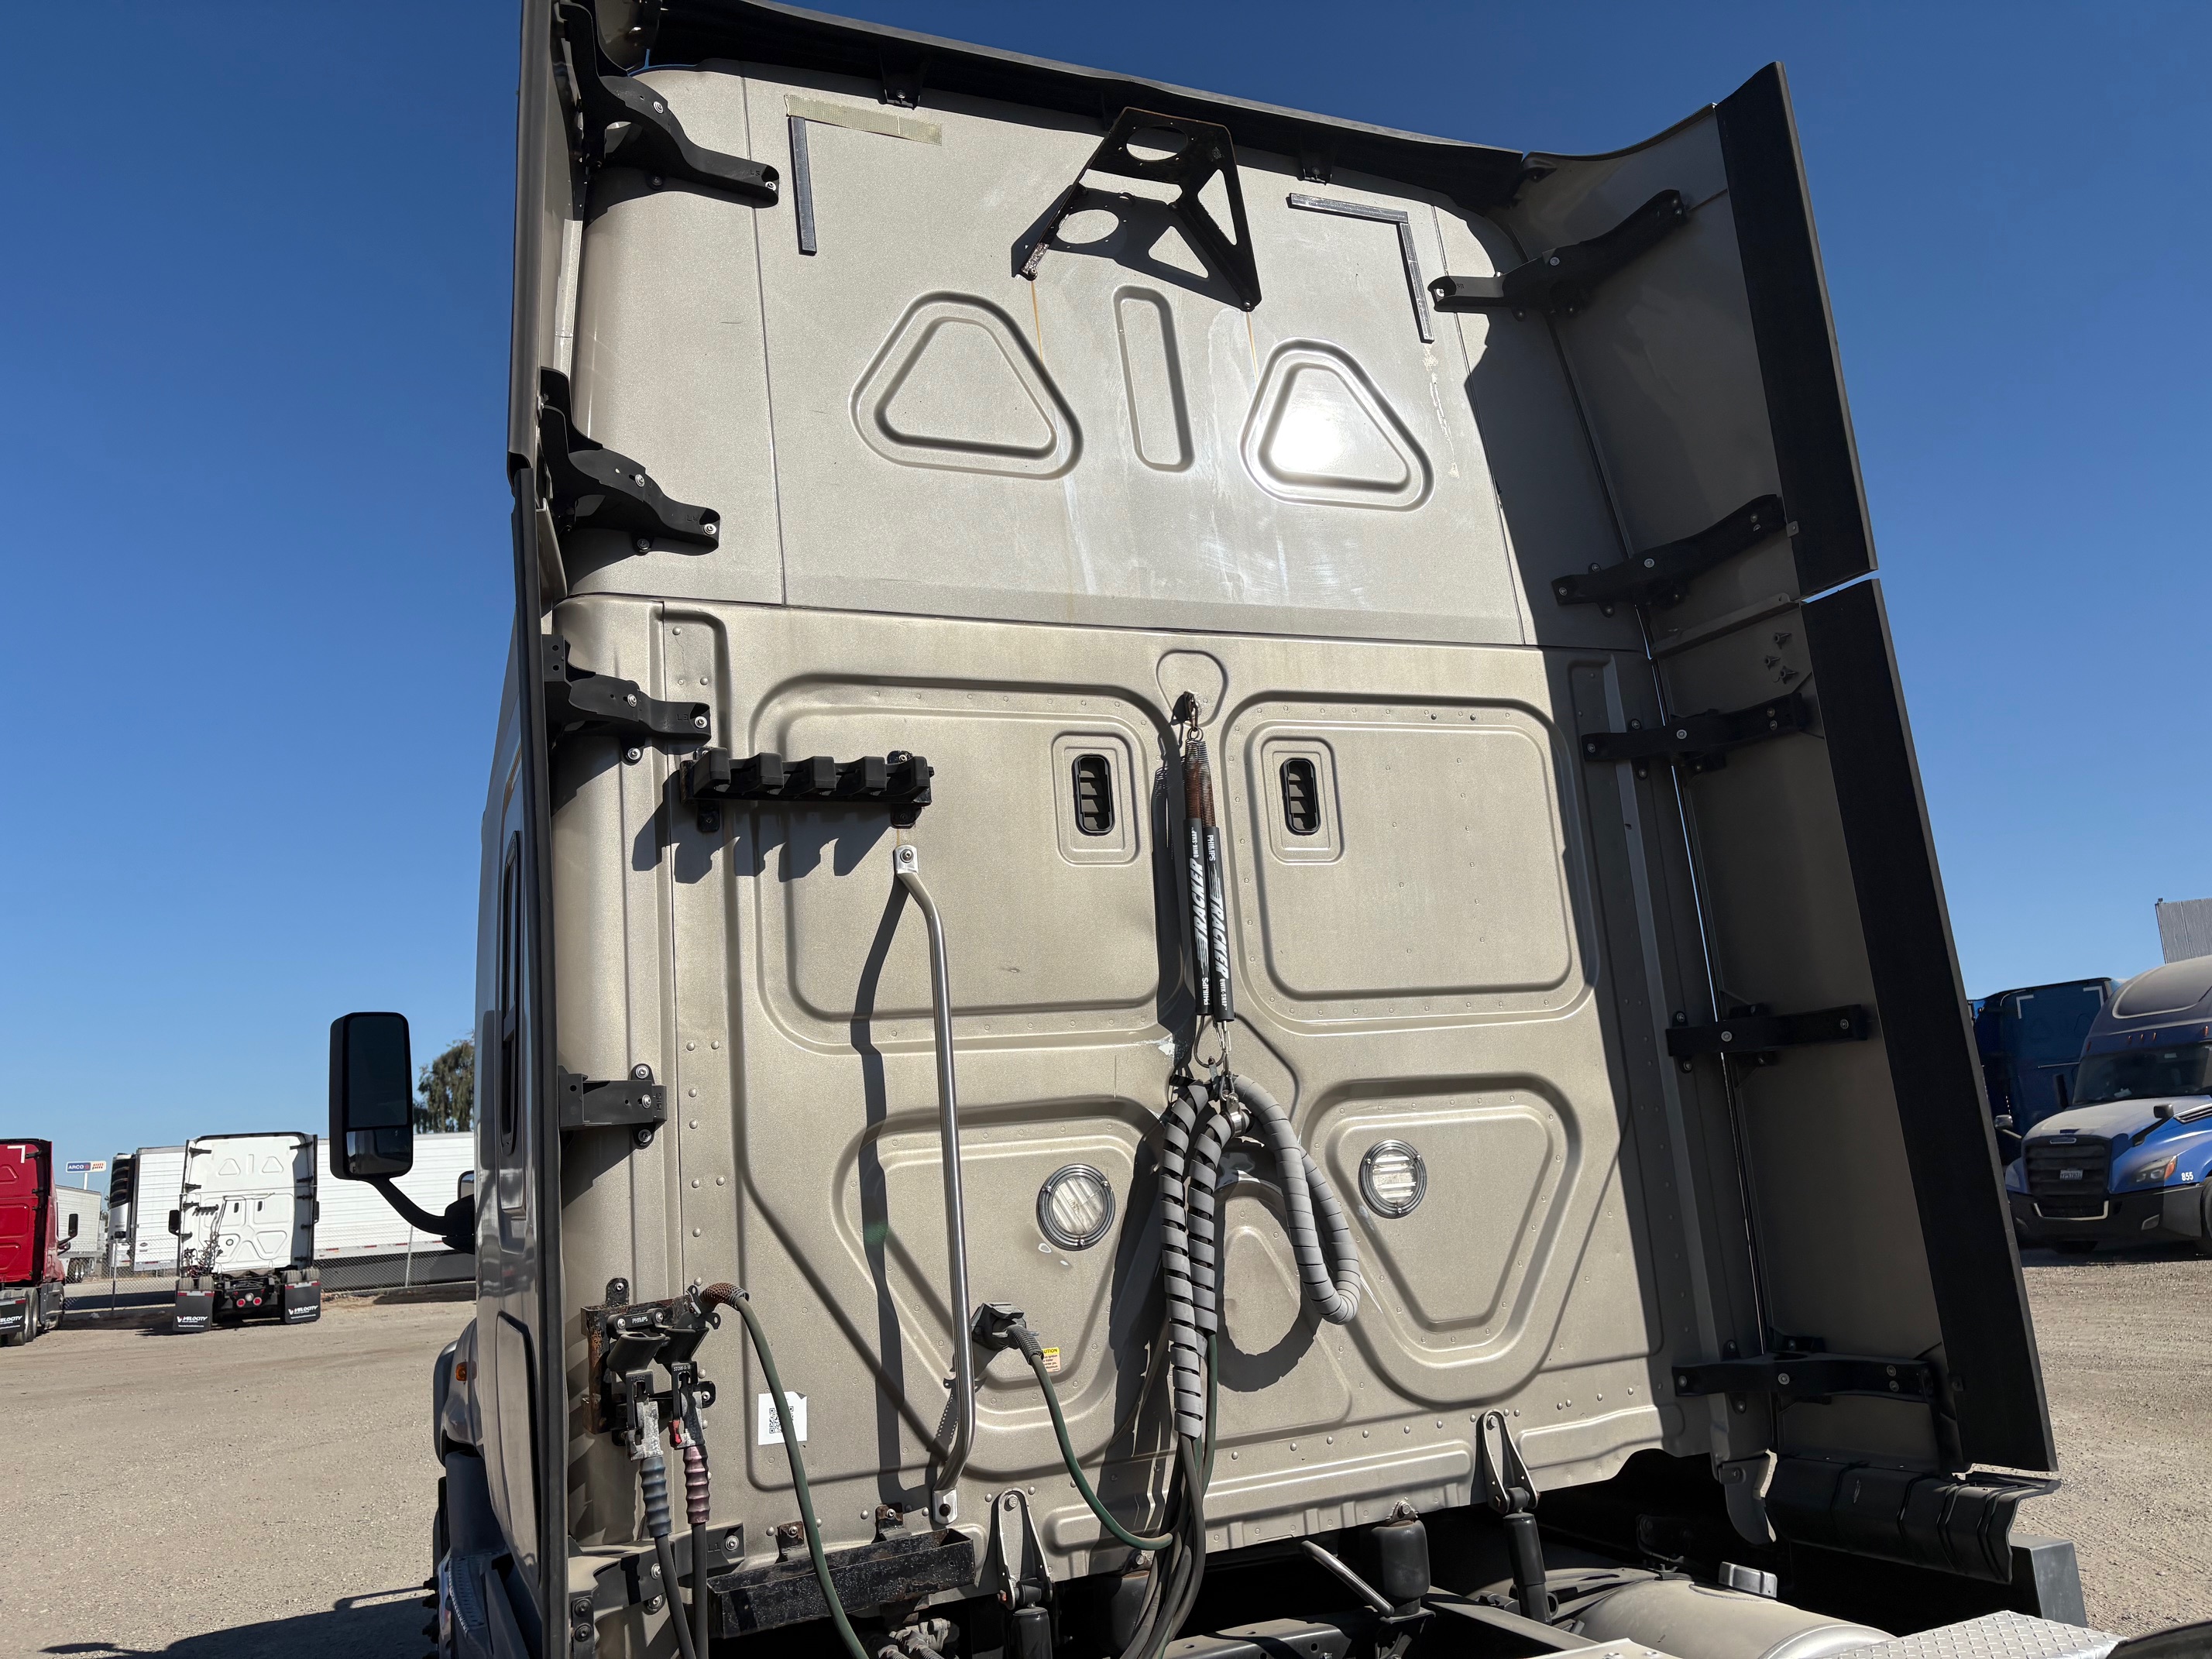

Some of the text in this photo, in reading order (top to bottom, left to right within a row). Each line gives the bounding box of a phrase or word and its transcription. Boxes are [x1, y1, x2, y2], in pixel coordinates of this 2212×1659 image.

[1190, 857, 1208, 943] TRACKER
[1210, 893, 1229, 980] TRACKER
[2181, 1171, 2194, 1181] 855
